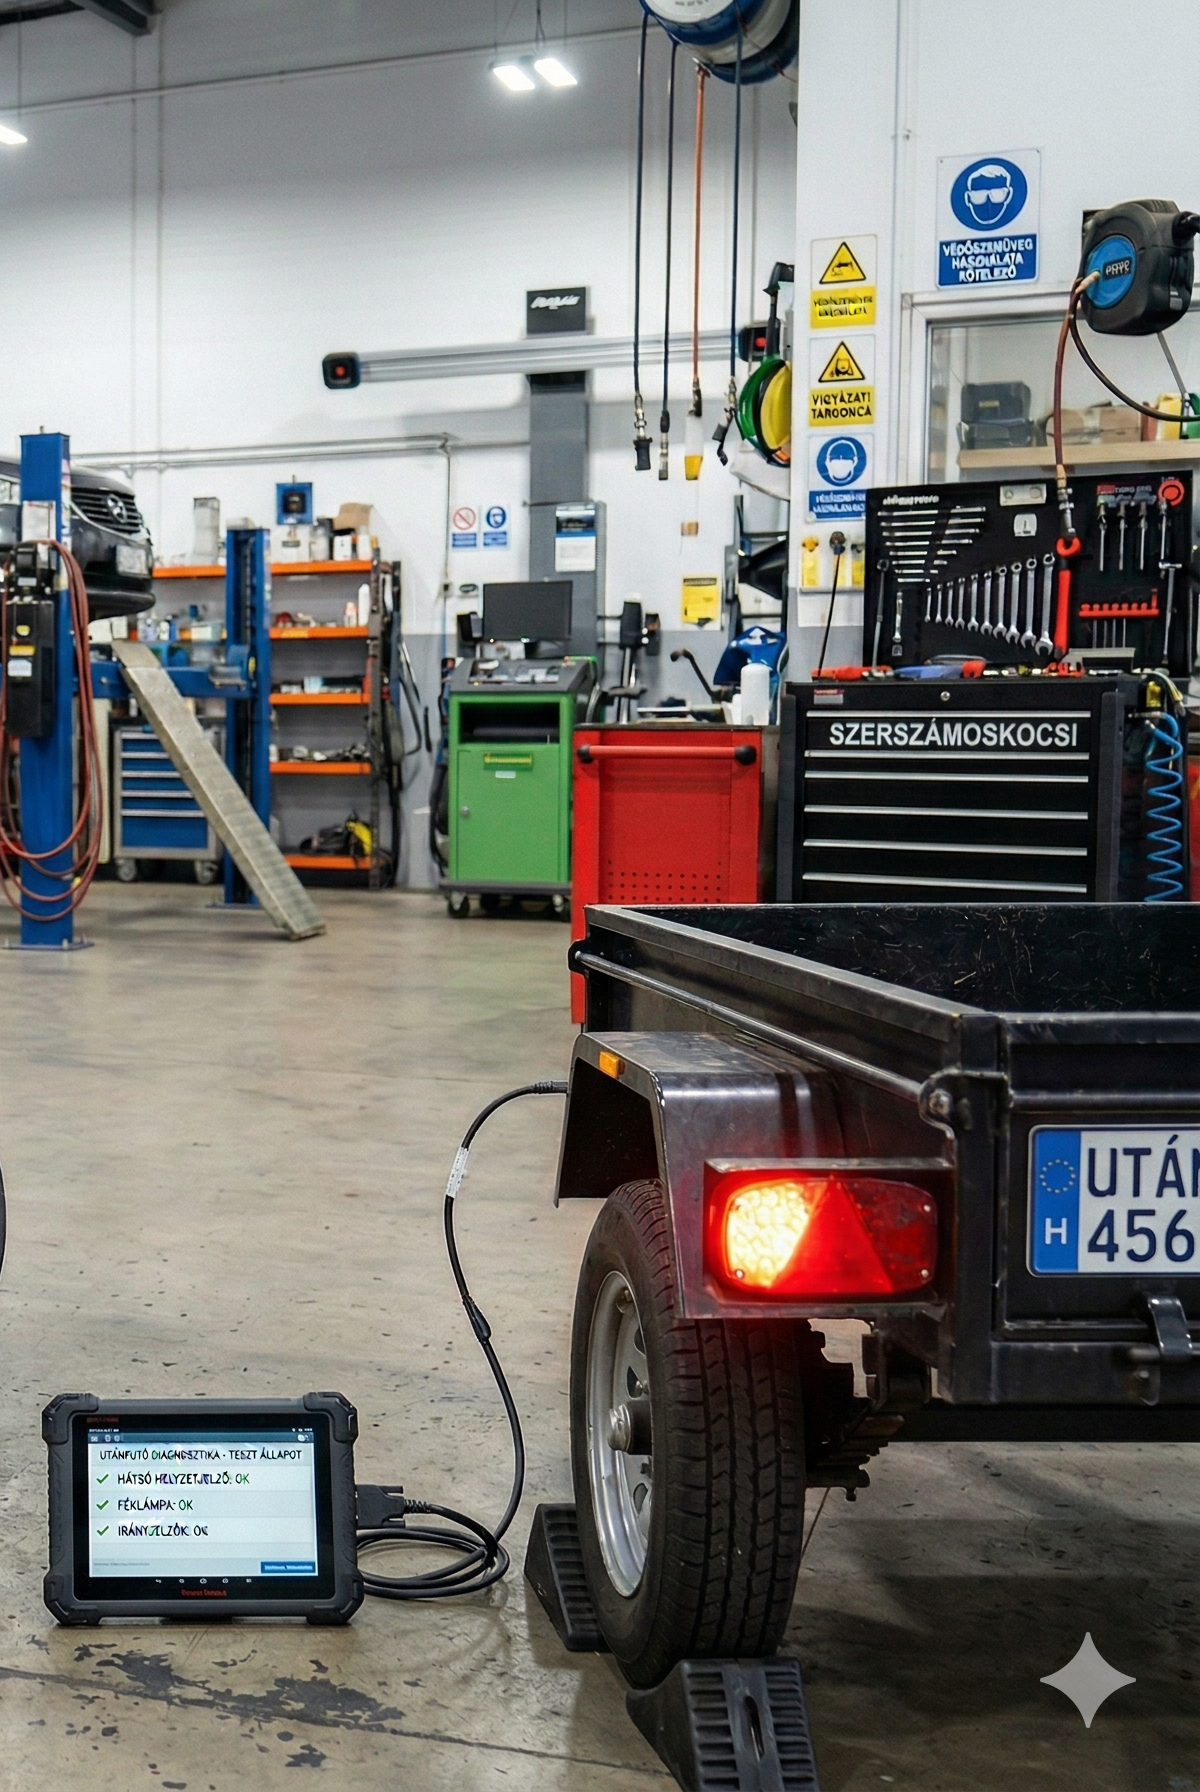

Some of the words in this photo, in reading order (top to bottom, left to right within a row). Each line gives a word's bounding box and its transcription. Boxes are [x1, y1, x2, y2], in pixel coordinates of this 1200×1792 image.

[829, 717, 1077, 747] SZERSZÁMOSKOCSI
[1044, 1217, 1068, 1245] H
[1087, 1209, 1195, 1263] 456
[260, 1447, 302, 1460] ÁLLAPOT
[117, 1471, 152, 1485] HÁTSÓ
[235, 1473, 250, 1485] OK
[178, 1499, 194, 1511] OK
